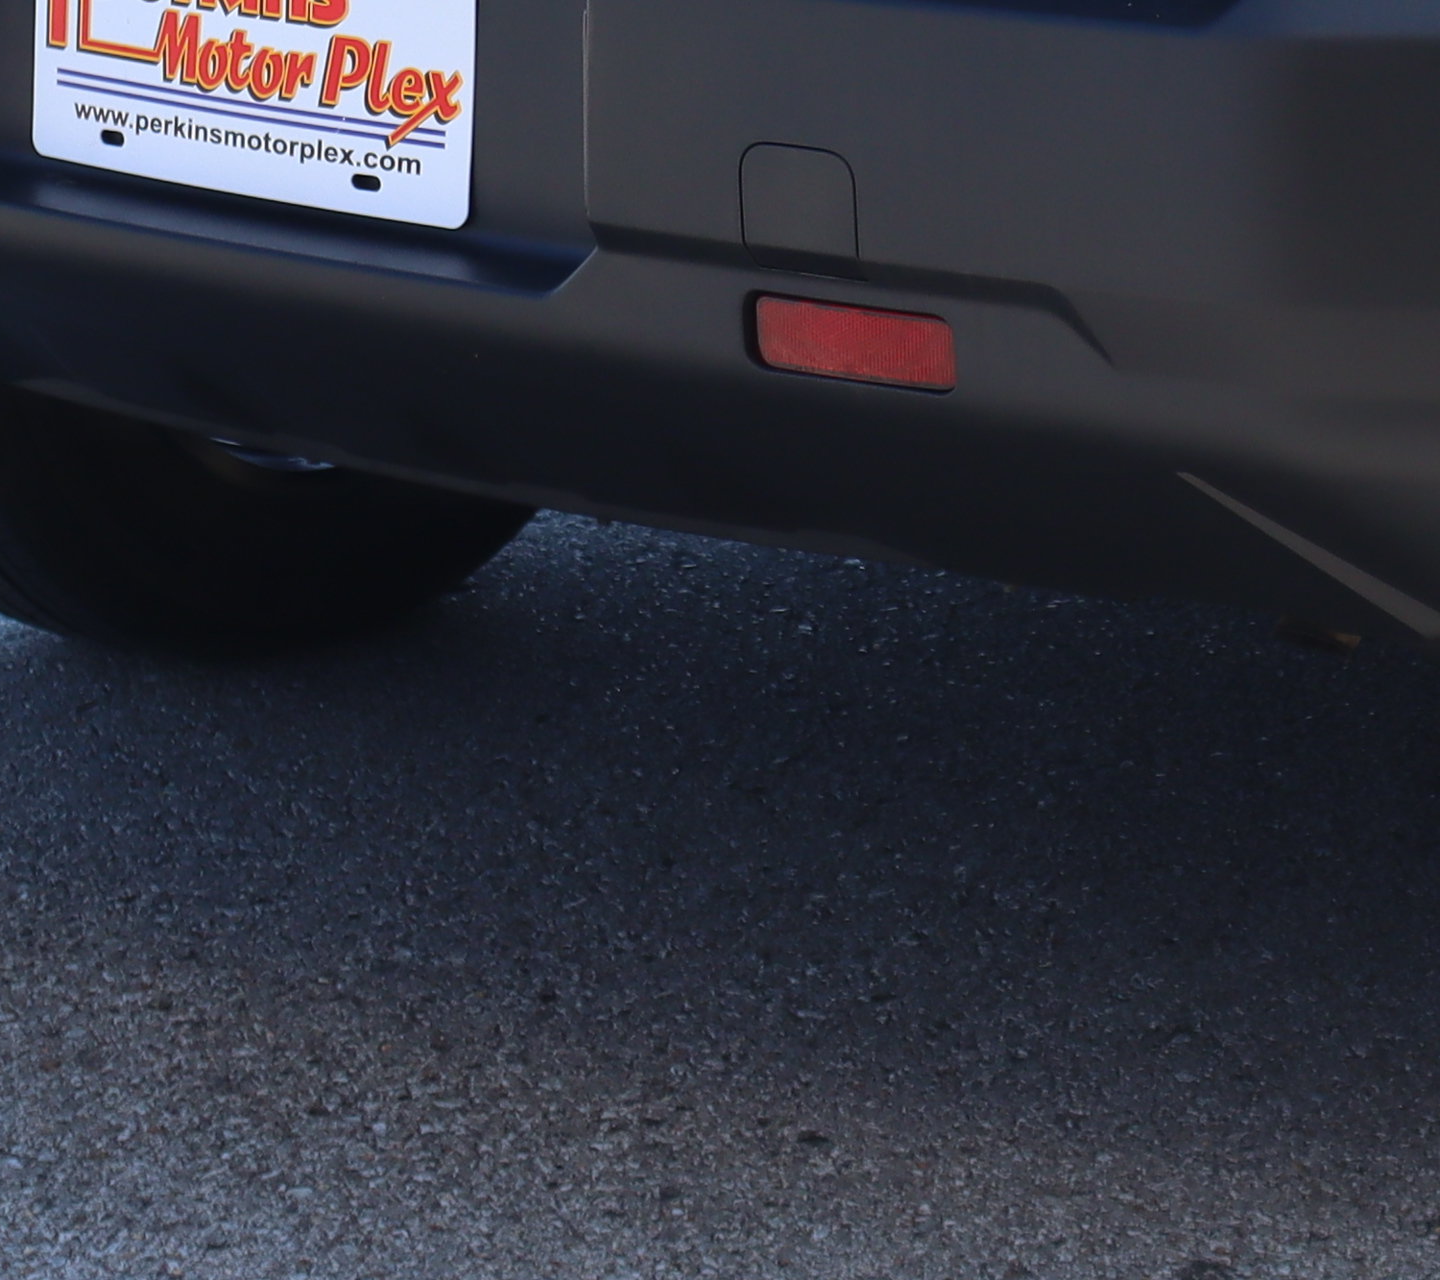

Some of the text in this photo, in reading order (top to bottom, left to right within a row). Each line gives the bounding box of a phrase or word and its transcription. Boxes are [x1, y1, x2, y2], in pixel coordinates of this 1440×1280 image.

[155, 9, 464, 146] Motor Plex
[74, 101, 422, 176] www.perkinsmotorplex.com
